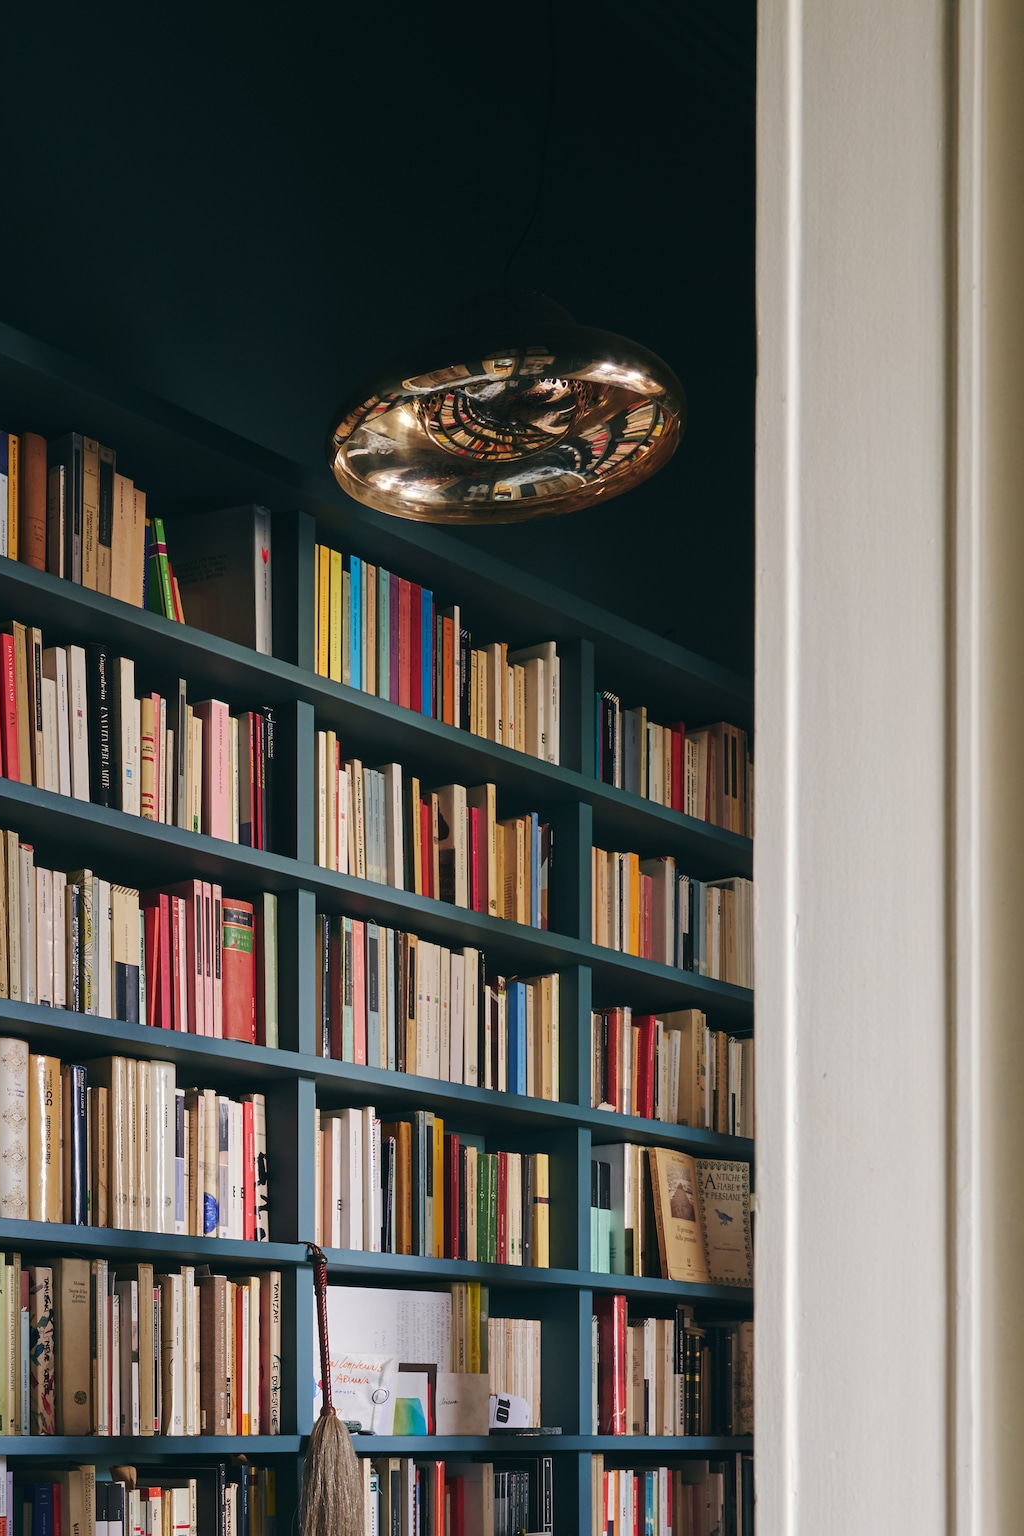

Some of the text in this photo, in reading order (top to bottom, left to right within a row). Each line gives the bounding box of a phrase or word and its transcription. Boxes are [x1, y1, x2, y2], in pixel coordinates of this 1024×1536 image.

[99, 653, 108, 700] Guggenheim
[44, 1091, 53, 1106] 55
[717, 1183, 735, 1191] FIABE
[710, 1192, 742, 1201] PERSIANE
[272, 1361, 279, 1371] LE
[496, 1397, 511, 1424] 10
